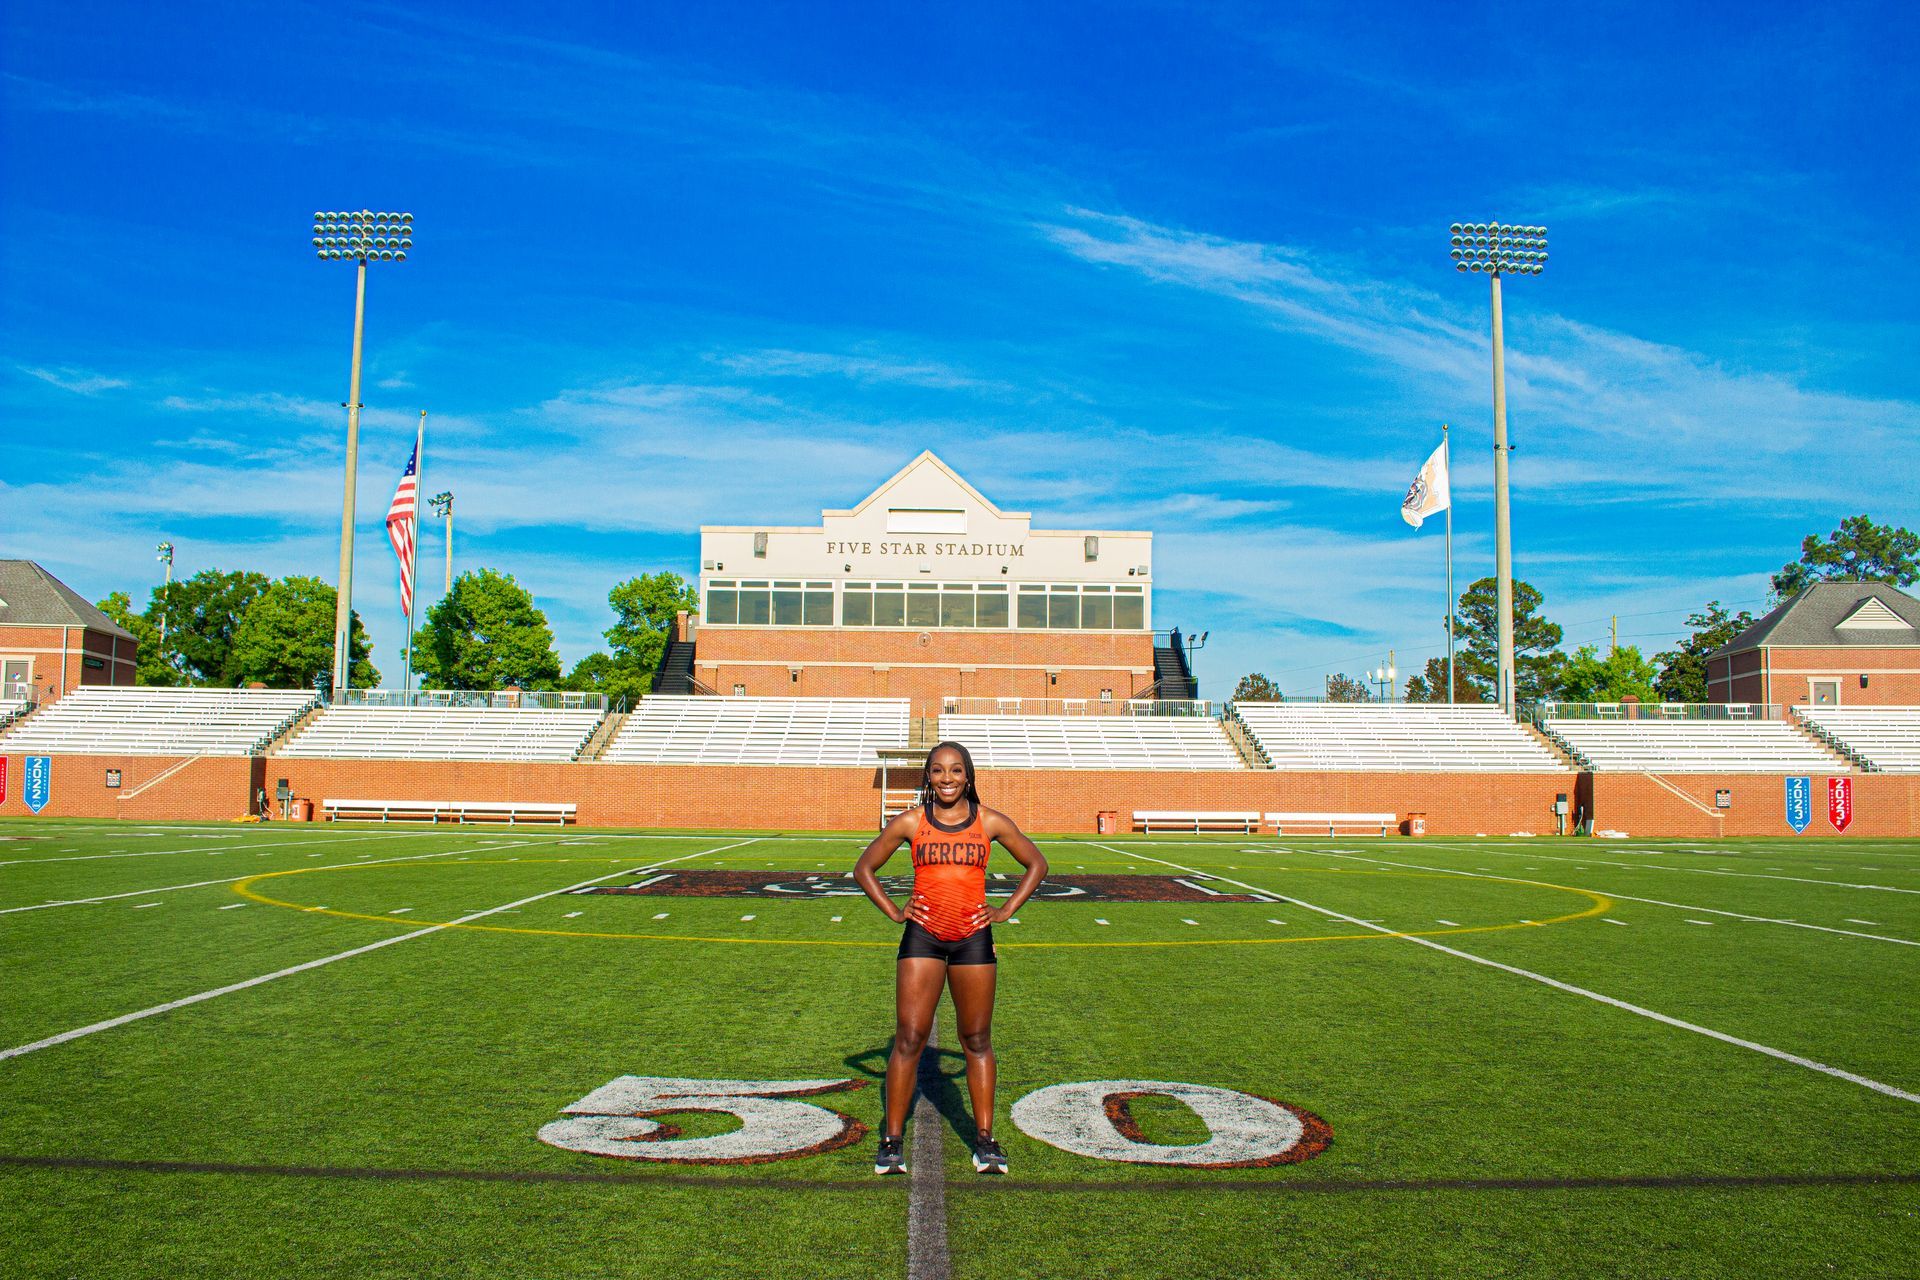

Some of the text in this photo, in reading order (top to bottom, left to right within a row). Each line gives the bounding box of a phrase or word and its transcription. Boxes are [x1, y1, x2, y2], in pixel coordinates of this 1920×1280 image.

[826, 542, 1024, 557] FIVE STAR STADIUM
[32, 758, 43, 799] 2022
[1793, 779, 1804, 820] 2023
[1835, 779, 1845, 820] 2023
[915, 842, 987, 868] MERCER
